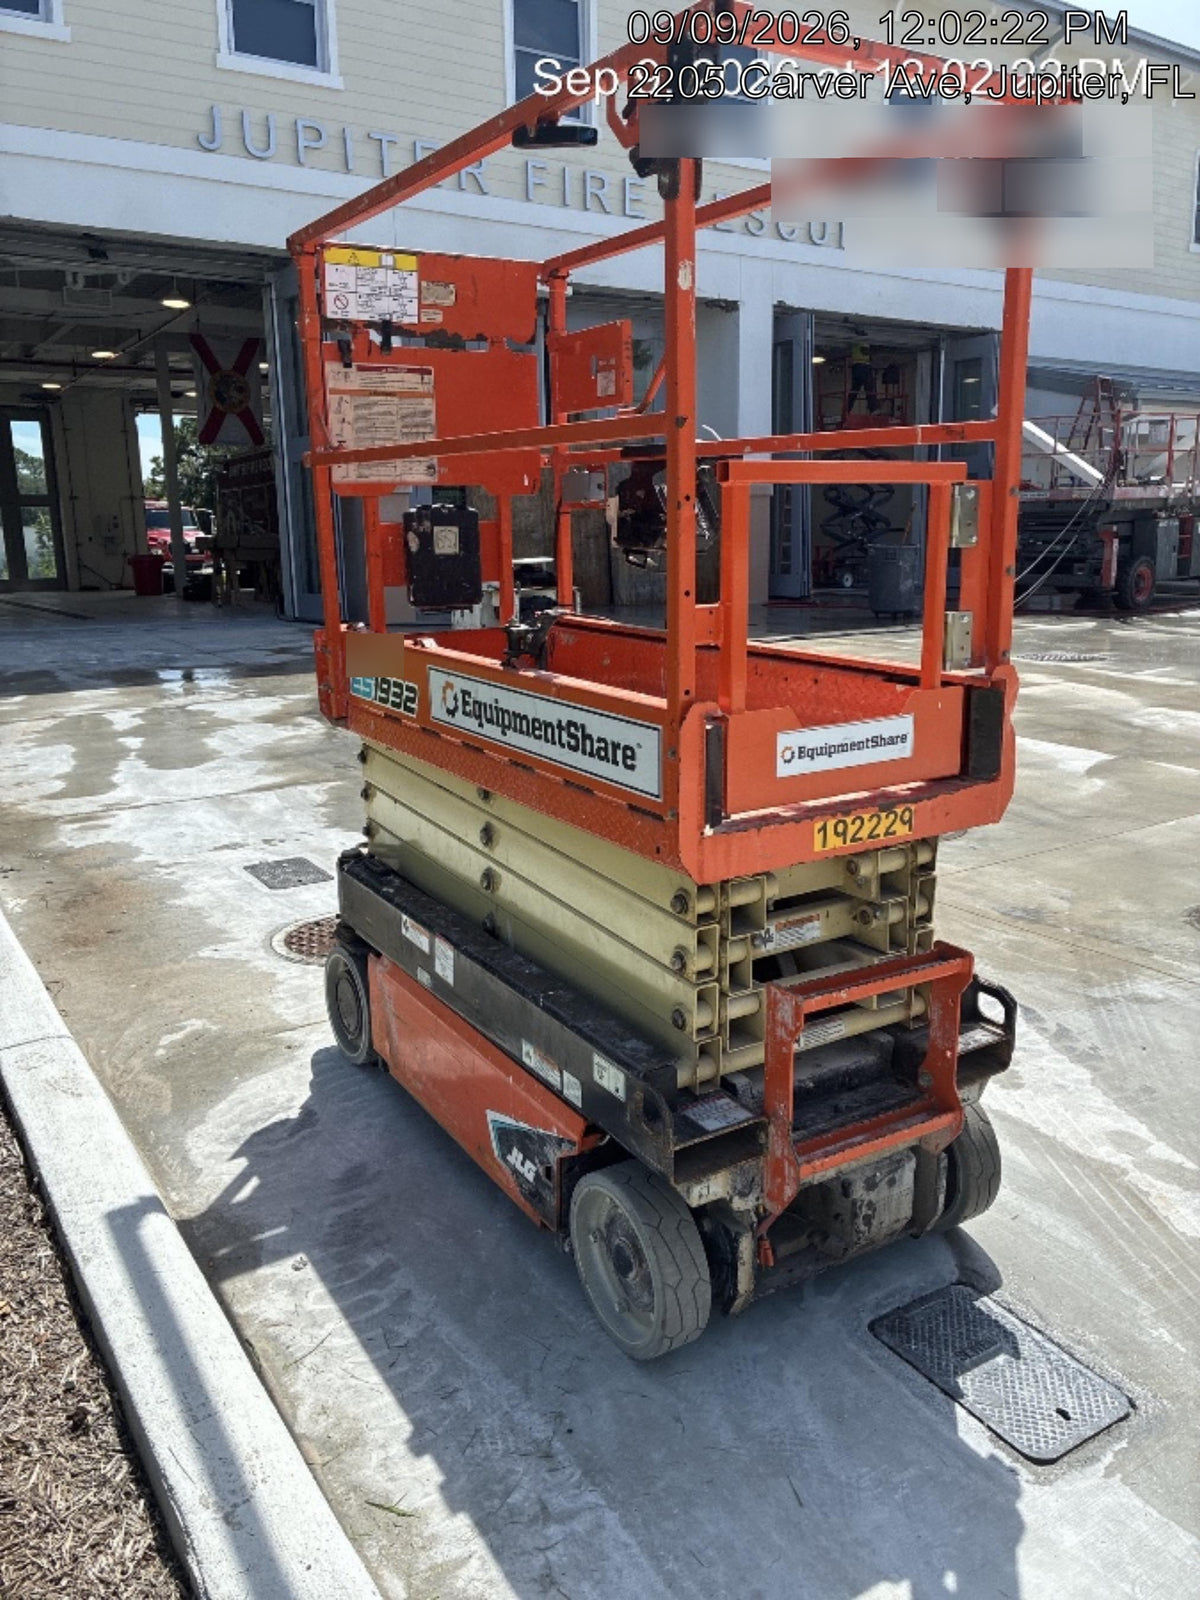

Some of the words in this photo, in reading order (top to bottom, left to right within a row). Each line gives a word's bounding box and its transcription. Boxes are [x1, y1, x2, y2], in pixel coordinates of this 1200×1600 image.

[525, 159, 646, 219] FIRE
[460, 688, 637, 771] EquipmentShare
[798, 733, 909, 760] EquipmentShare
[817, 807, 913, 849] 192229
